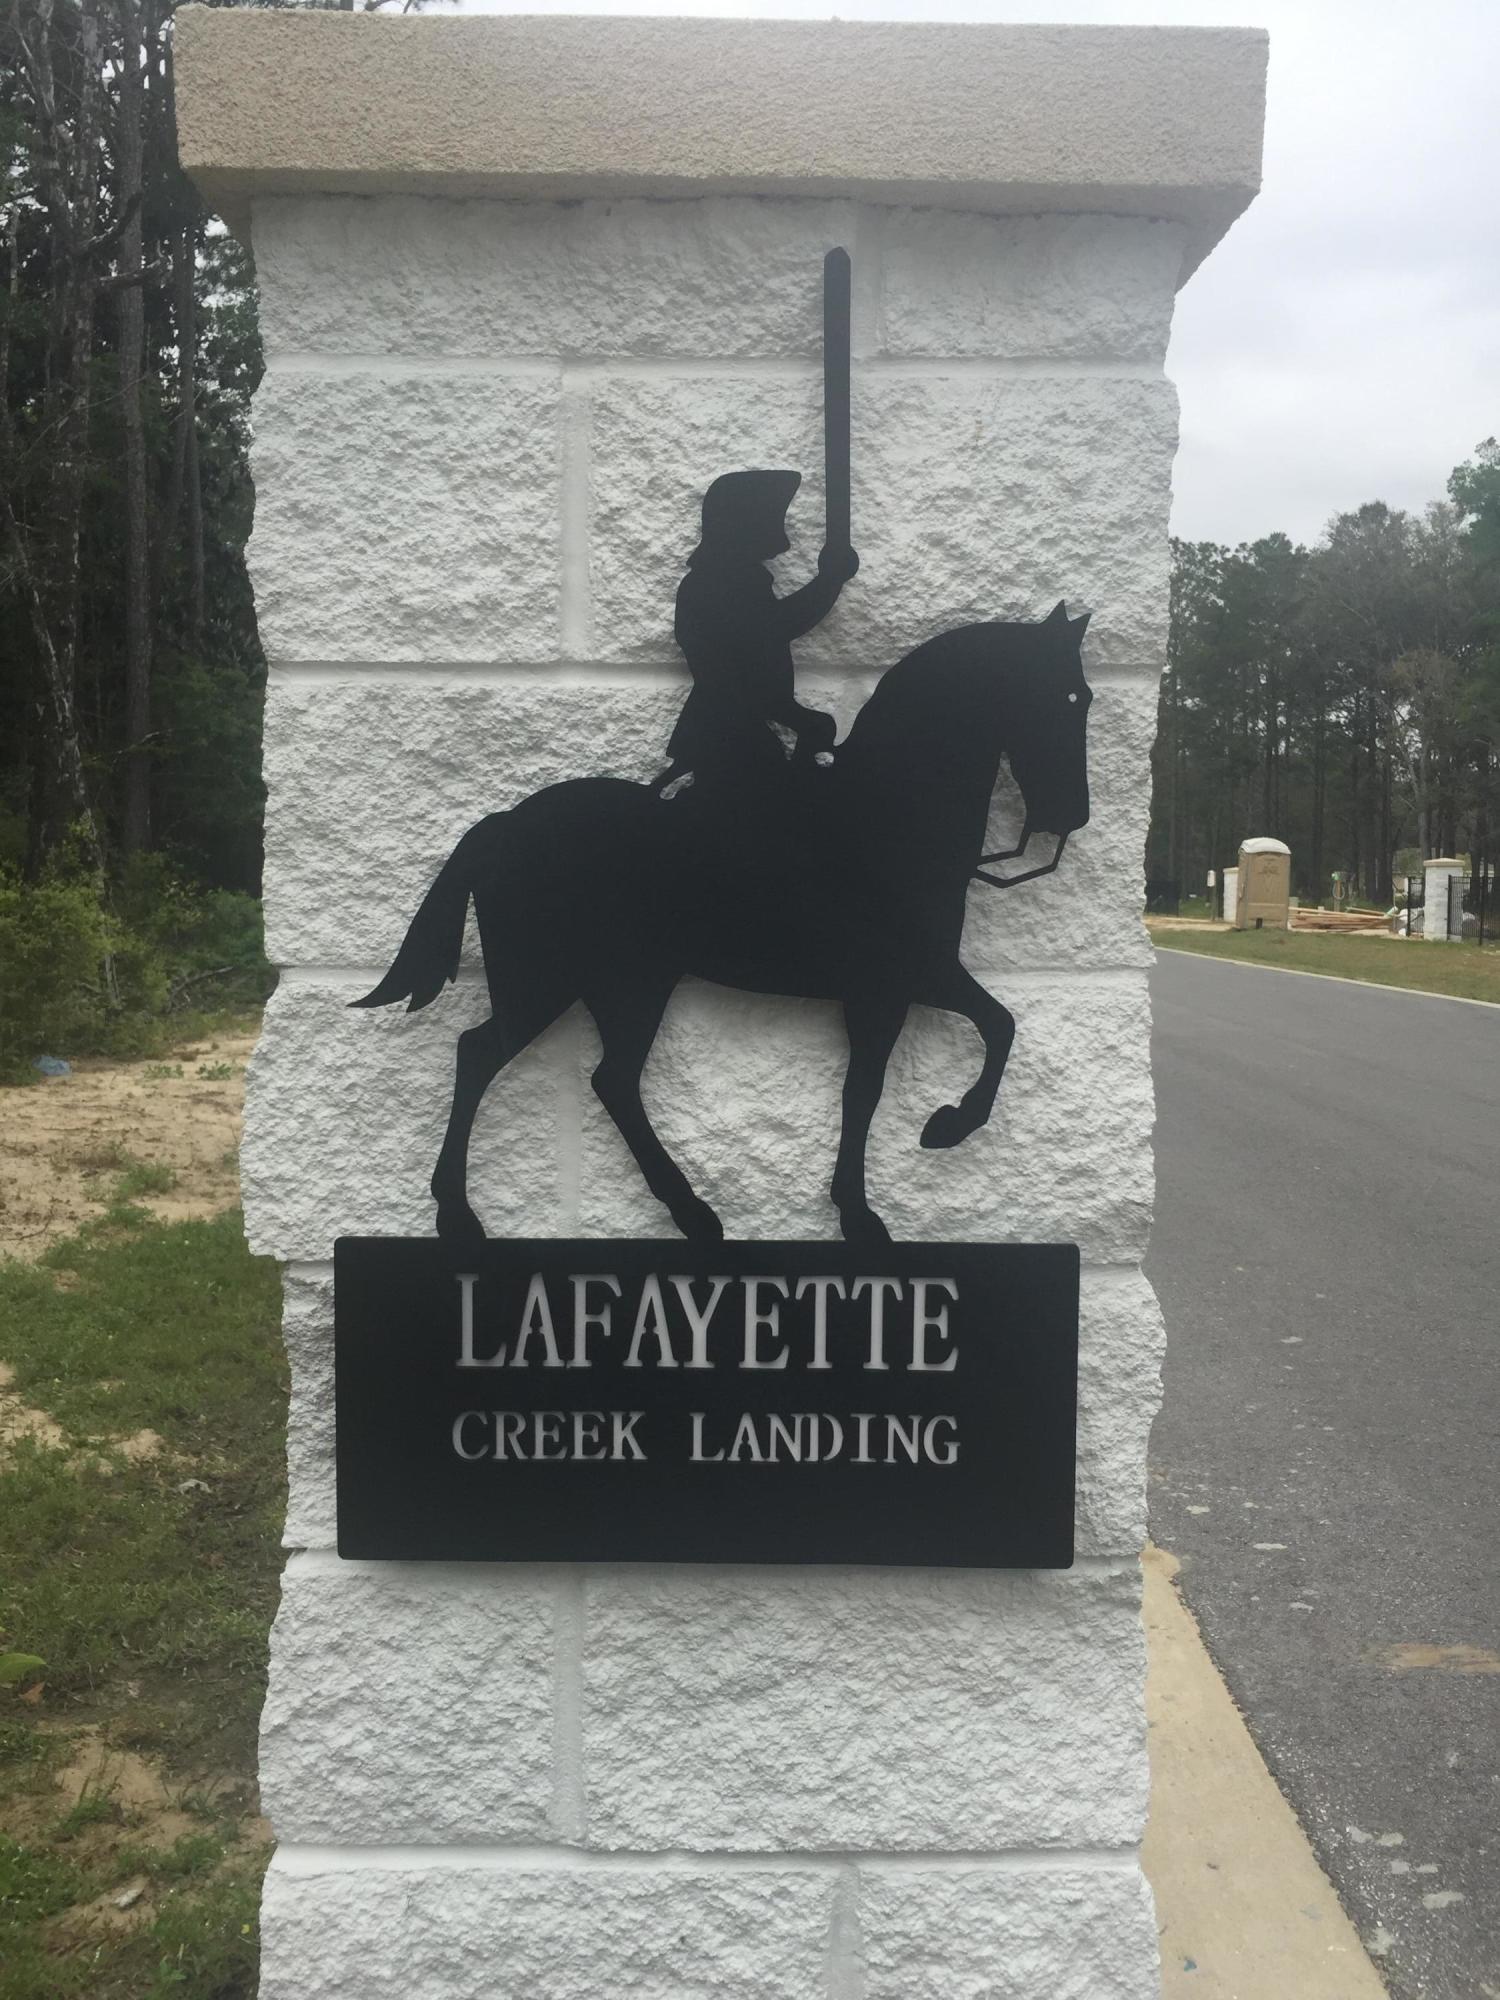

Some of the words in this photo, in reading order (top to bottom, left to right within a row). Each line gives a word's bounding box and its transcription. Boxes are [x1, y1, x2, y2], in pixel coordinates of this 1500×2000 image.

[457, 1273, 960, 1372] LAFAYETTE
[451, 1411, 649, 1462] CREEK
[689, 1412, 960, 1467] LANDING
